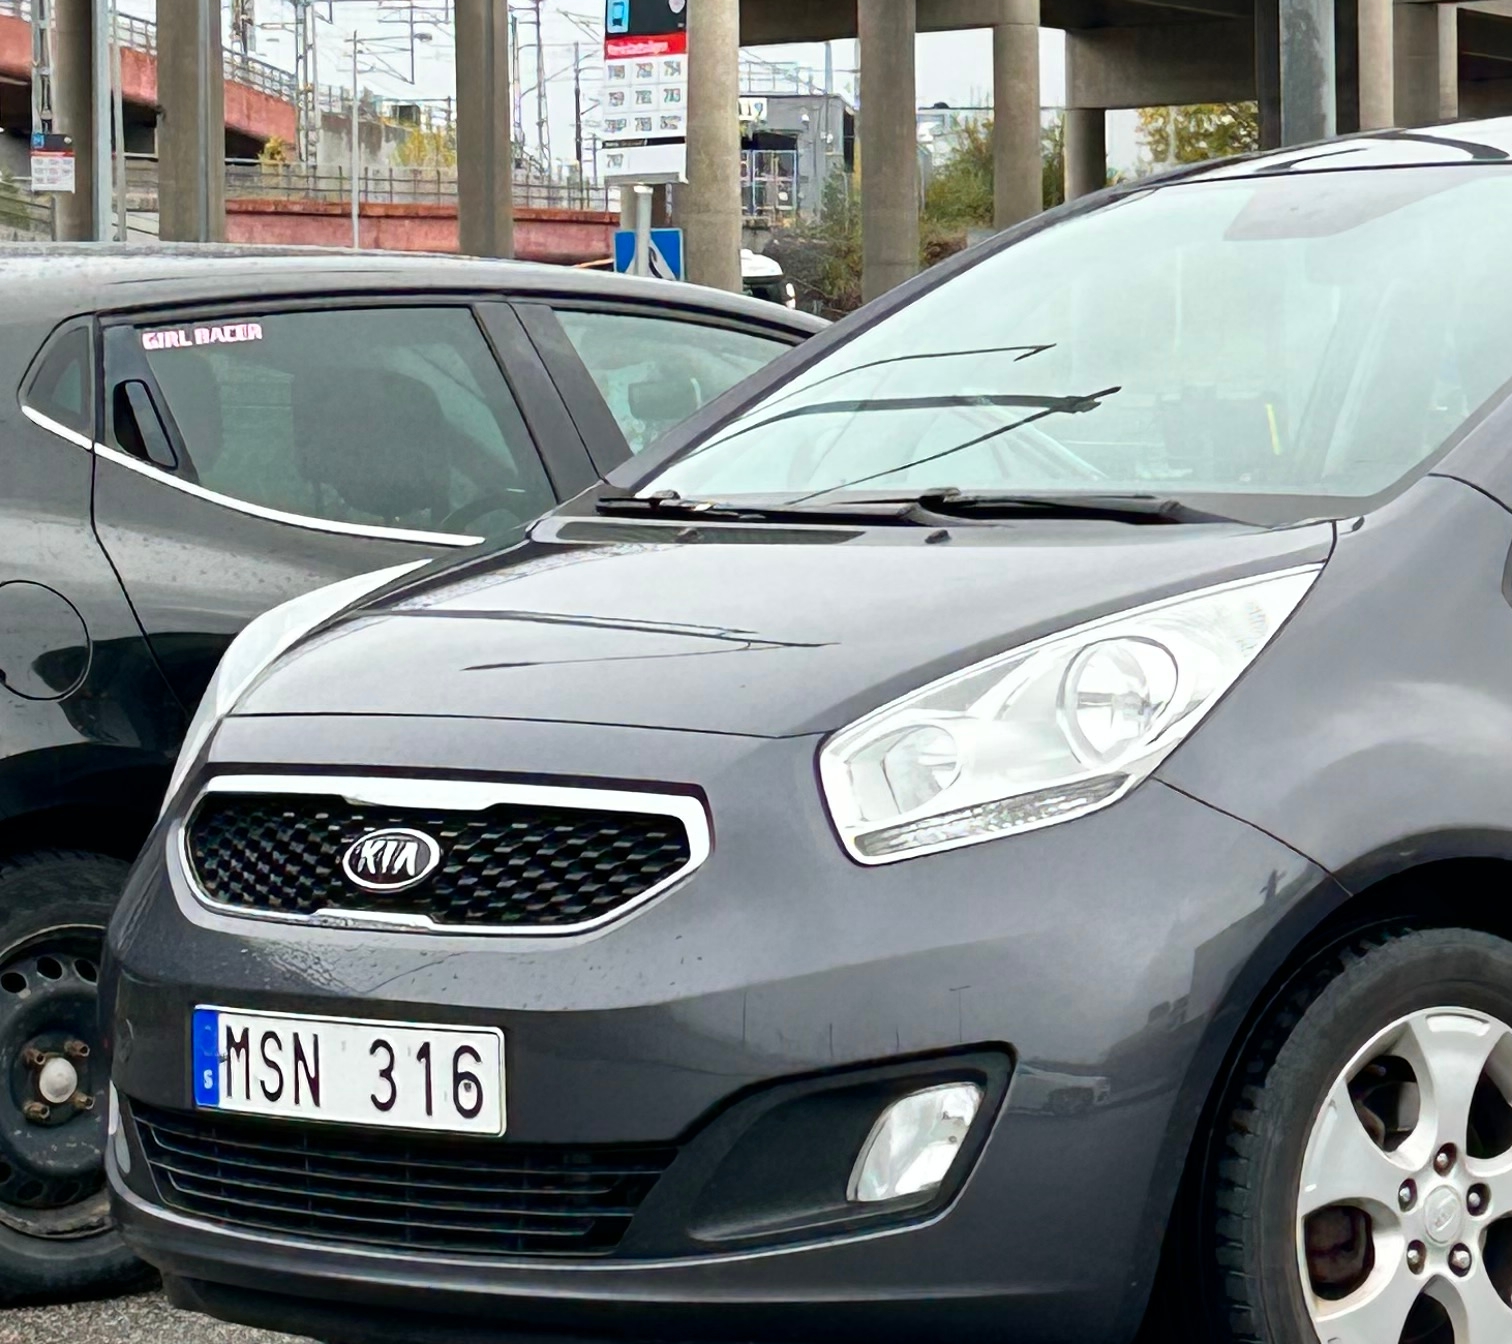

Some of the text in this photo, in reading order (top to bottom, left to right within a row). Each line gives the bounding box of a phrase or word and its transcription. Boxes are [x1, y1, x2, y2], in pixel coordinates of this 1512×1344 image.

[142, 323, 263, 350] GIRL RACER
[356, 839, 421, 876] KIA
[203, 1069, 213, 1089] S
[226, 1025, 483, 1119] MSN 316
